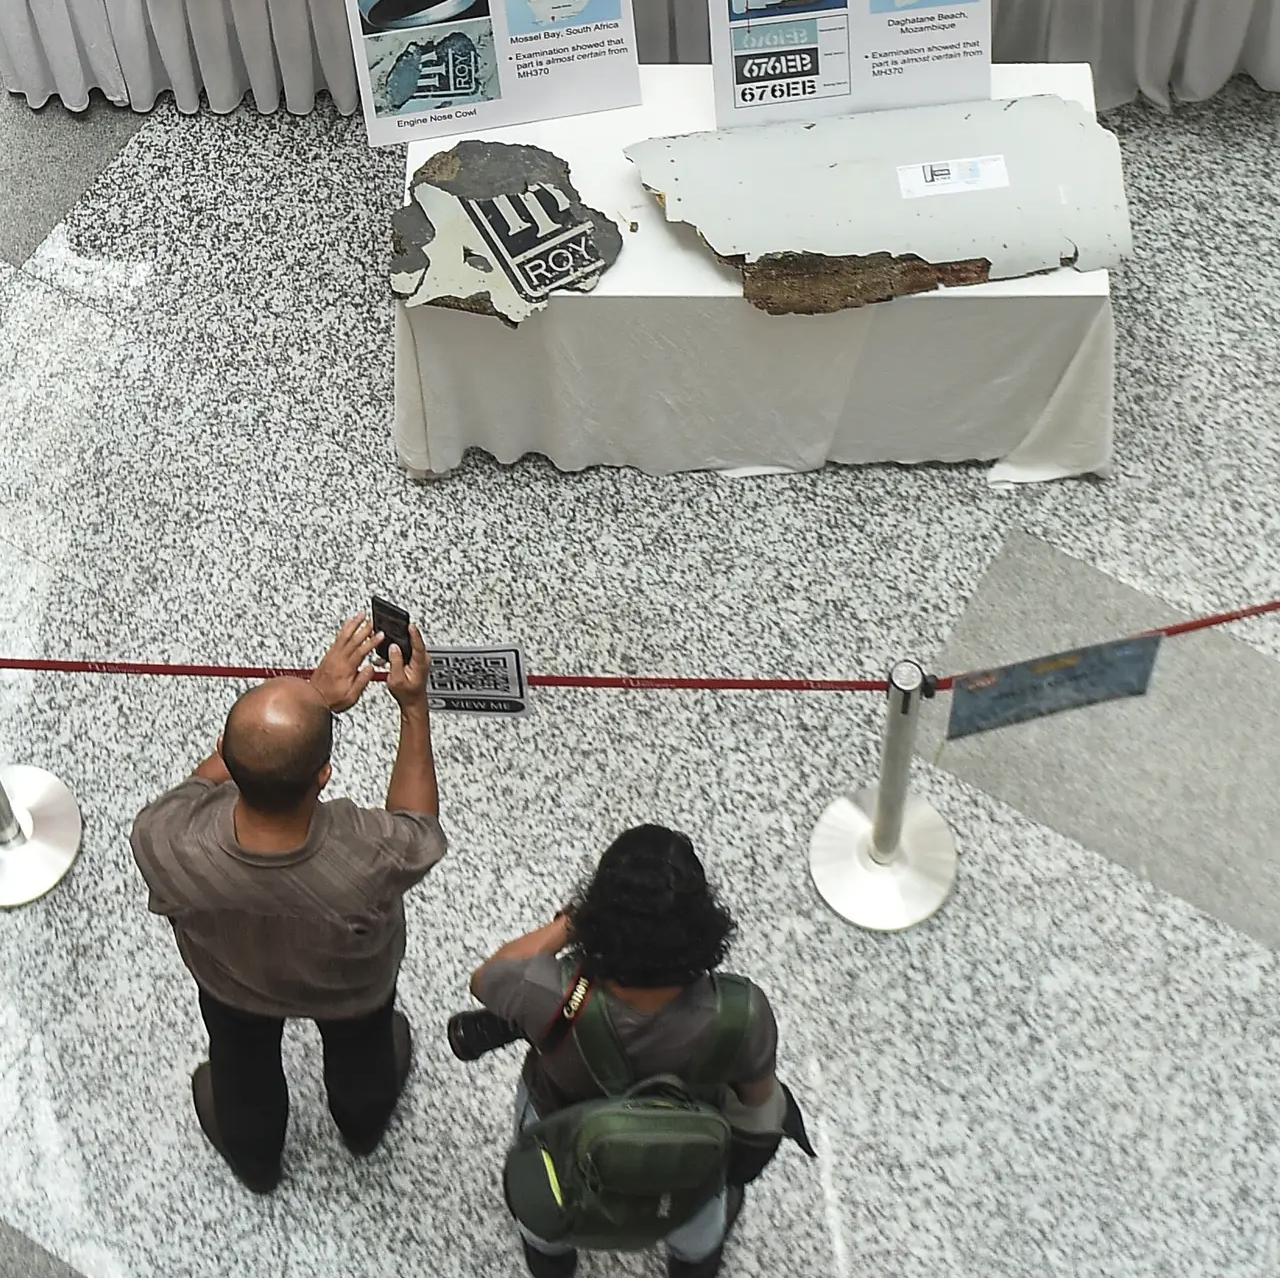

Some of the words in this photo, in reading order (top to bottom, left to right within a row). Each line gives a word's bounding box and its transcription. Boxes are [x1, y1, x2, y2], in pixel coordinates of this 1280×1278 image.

[937, 11, 969, 21] Beach,
[509, 32, 542, 45] Mossel
[543, 31, 564, 40] Bay,
[565, 25, 592, 36] South
[593, 22, 620, 32] Africa
[899, 22, 956, 35] Mozambique
[515, 46, 570, 61] Examination
[571, 40, 605, 52] showed
[606, 37, 625, 47] that
[871, 47, 926, 60] Examination
[926, 42, 961, 53] showed
[962, 40, 980, 49] that
[516, 60, 536, 72] part
[535, 59, 544, 67] is
[545, 54, 575, 66] almost
[576, 50, 607, 61] certain
[607, 47, 629, 55] from
[742, 53, 812, 78] 676EB
[871, 60, 890, 70] part
[900, 55, 930, 65] almost
[931, 52, 962, 62] certain
[962, 49, 983, 57] from
[517, 67, 550, 79] MH370
[871, 66, 904, 77] MH370
[740, 79, 817, 103] 676EB
[396, 117, 428, 128] Engine
[429, 113, 453, 123] Nose
[454, 108, 477, 119] Cowl
[450, 701, 486, 710] VIEW
[490, 701, 510, 710] ME
[563, 976, 589, 1019] Canon
